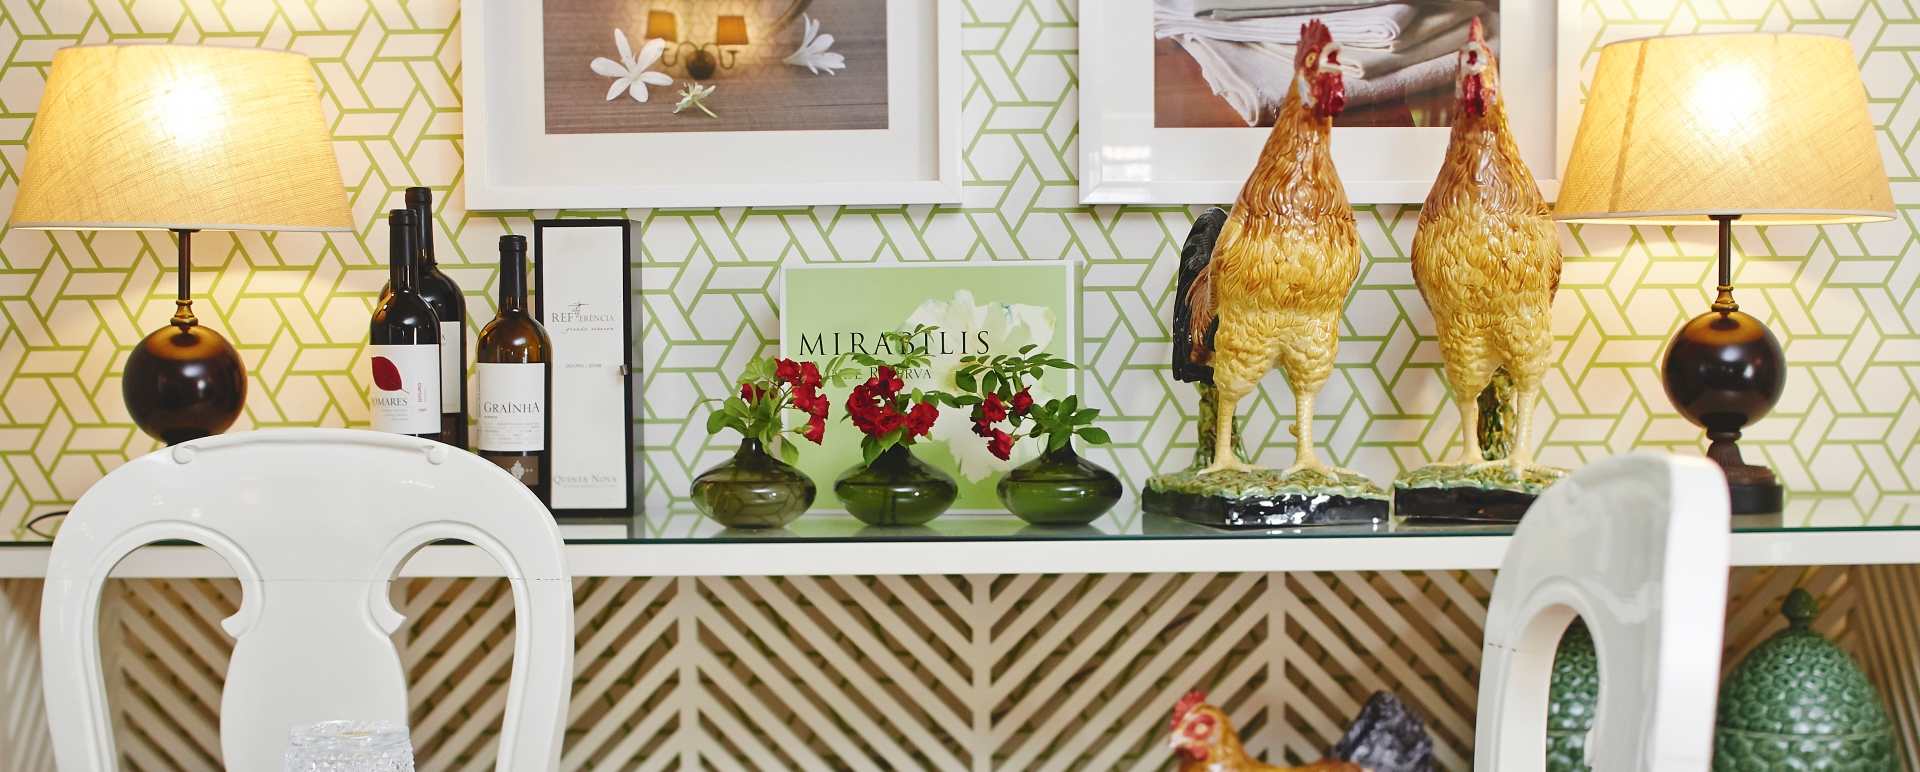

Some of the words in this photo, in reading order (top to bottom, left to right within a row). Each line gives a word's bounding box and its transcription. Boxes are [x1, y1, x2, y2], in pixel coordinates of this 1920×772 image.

[799, 330, 991, 356] MIRABILIS
[870, 367, 932, 380] RRVA
[371, 397, 408, 407] OMARES
